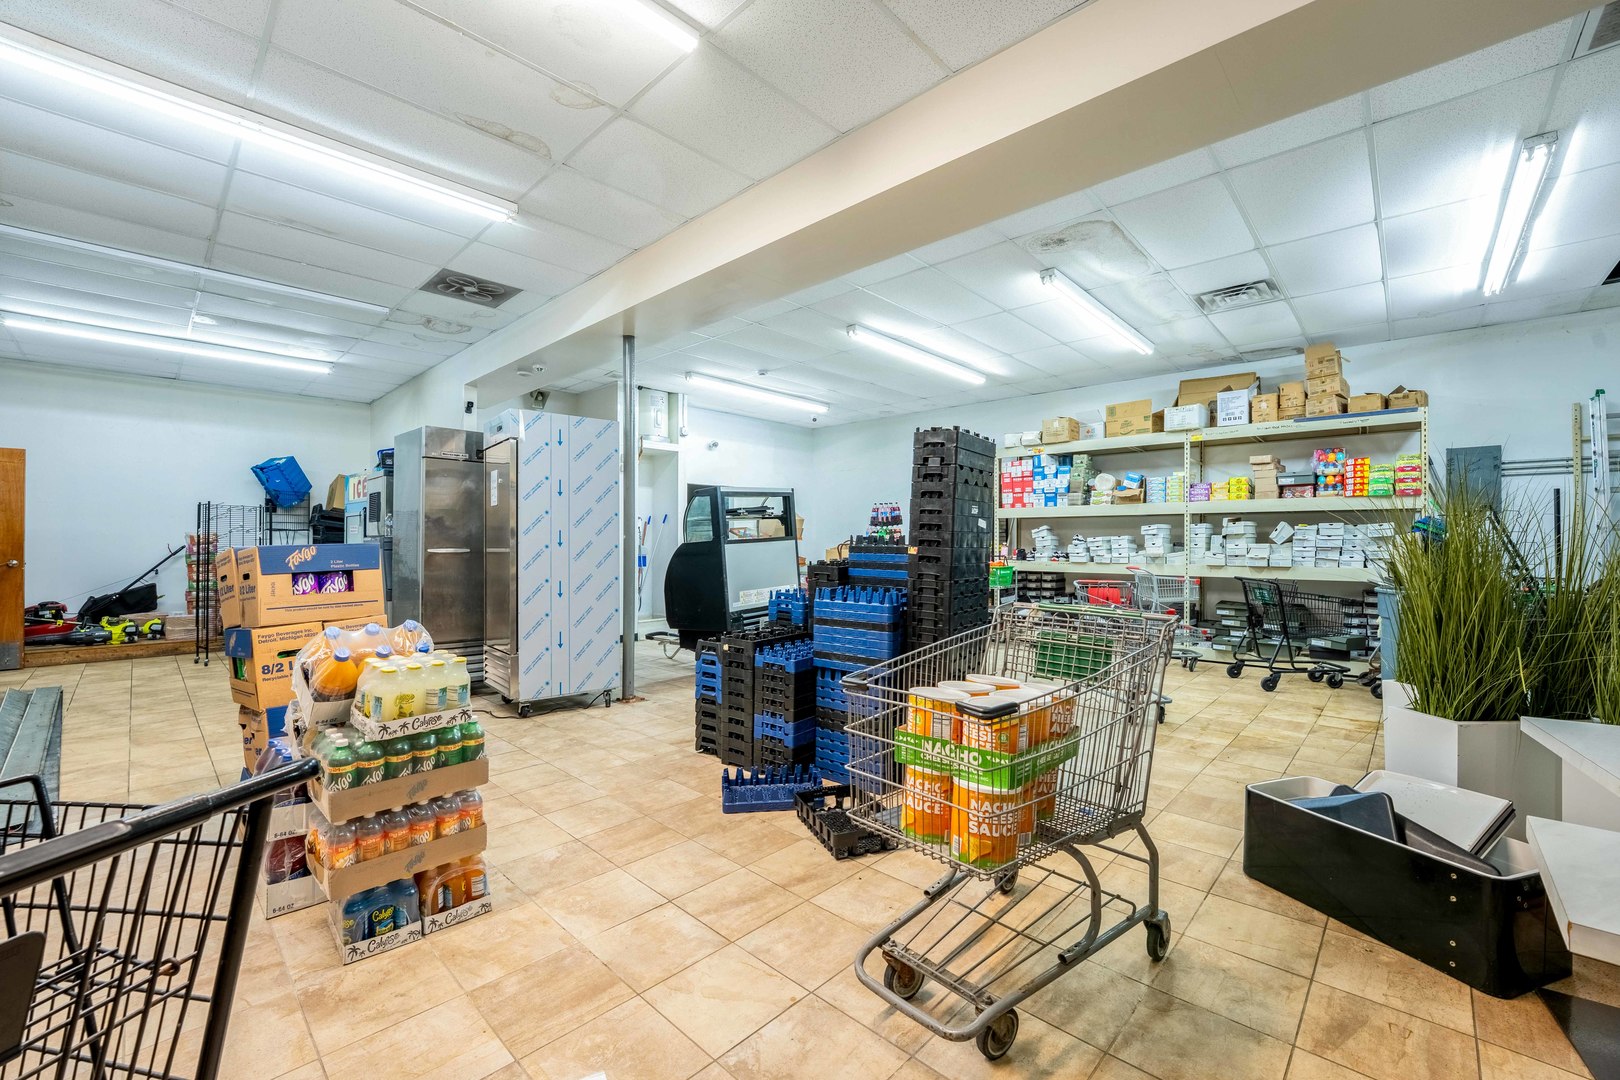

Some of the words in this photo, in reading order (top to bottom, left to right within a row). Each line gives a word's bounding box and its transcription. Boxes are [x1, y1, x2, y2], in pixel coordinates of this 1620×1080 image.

[353, 477, 367, 499] ICE
[285, 545, 317, 570] Faygo
[261, 662, 284, 675] 8/2
[411, 714, 443, 730] Calypso
[922, 739, 982, 767] NACHO
[372, 906, 394, 922] Calypso
[445, 904, 473, 925] Calypso
[367, 932, 400, 953] Calypso
